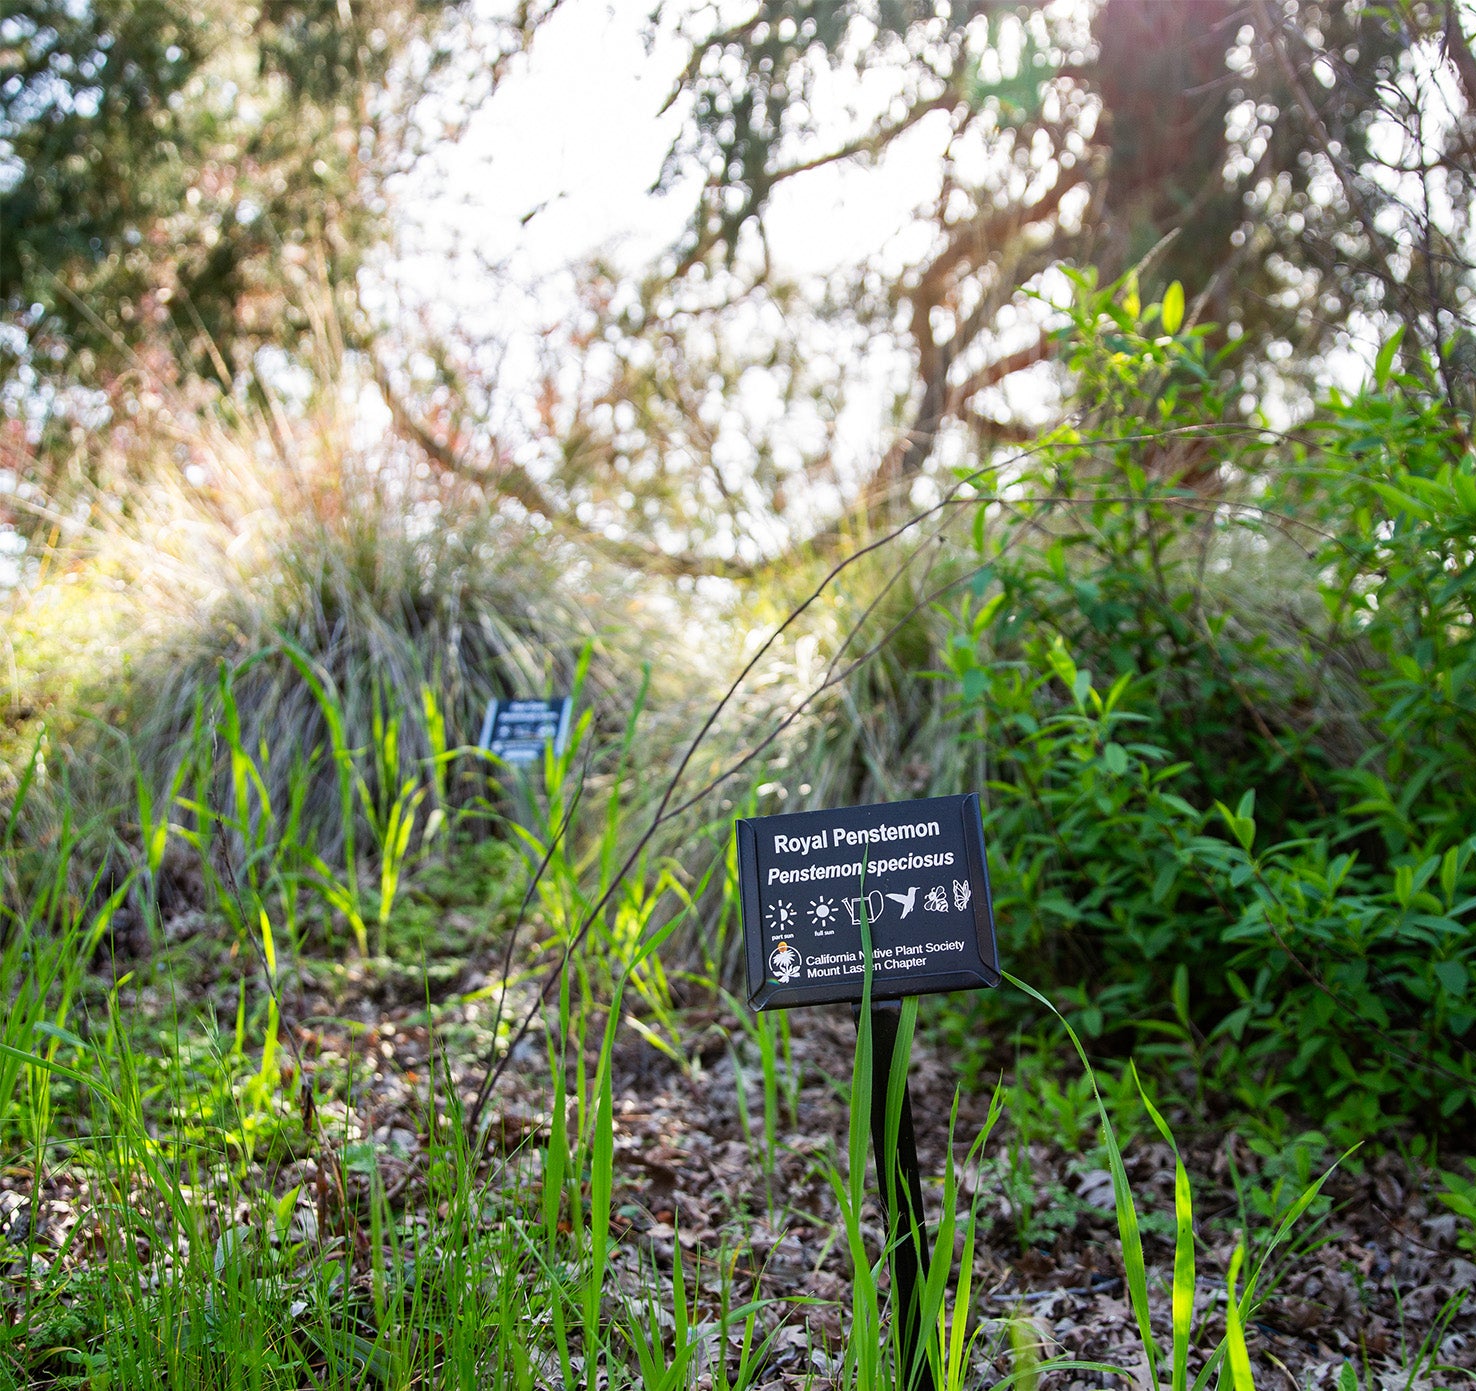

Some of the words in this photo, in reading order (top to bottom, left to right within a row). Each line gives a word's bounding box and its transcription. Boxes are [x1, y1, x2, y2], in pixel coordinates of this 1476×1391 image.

[774, 830, 829, 855] Royal
[833, 821, 940, 847] Penstemon
[767, 861, 863, 885] Penstemon
[867, 851, 955, 877] speciosus
[806, 952, 857, 966] California
[858, 948, 893, 960] Ntive
[895, 943, 923, 956] Plant
[925, 939, 965, 953] Society
[807, 965, 841, 978] Mount
[842, 962, 882, 975] Lassn
[884, 956, 927, 970] Chapter
